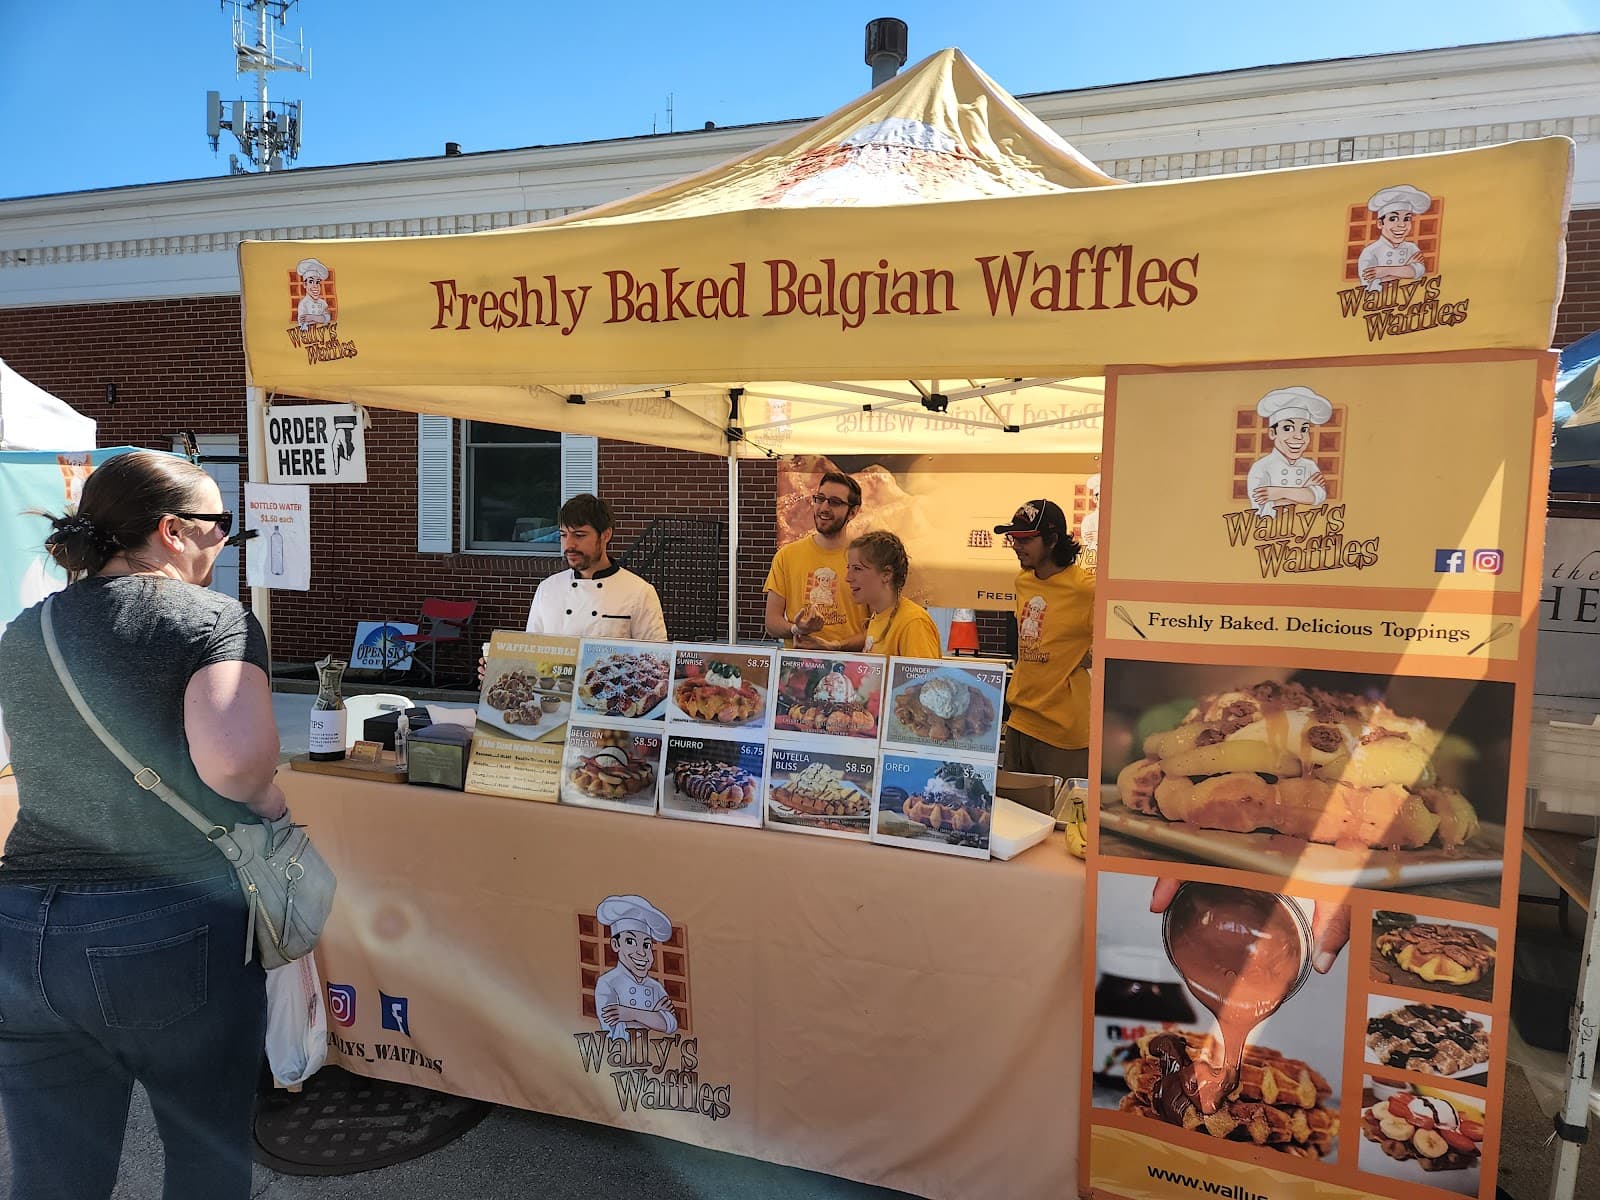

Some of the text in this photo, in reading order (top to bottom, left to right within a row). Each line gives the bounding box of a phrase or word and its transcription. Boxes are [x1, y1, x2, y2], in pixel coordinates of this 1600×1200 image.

[430, 242, 1200, 336] Freshly Baked Belgian Waffles
[1337, 275, 1442, 318] Wally's
[1363, 298, 1469, 341] Waffles
[286, 322, 338, 349] Wally's
[305, 339, 358, 366] Waffles
[269, 415, 329, 446] ORDER
[278, 448, 327, 476] HERE
[250, 501, 303, 511] BOTTLED WATER
[1223, 503, 1346, 548] Wally's
[1255, 535, 1380, 579] Waffles
[1148, 611, 1471, 642] Freshly Baked. Delicious Toppings
[676, 658, 703, 666] SUNRISE
[747, 658, 769, 668] $8.75
[782, 660, 825, 670] CHERRY MAMA
[856, 665, 881, 676] $7.75
[976, 673, 1002, 684] $7.75
[570, 729, 603, 740] BELGIAN
[569, 738, 597, 747] DREAM
[633, 736, 658, 748] $8.50
[669, 739, 704, 750] CHURRO
[740, 744, 764, 756] $6.75
[772, 751, 810, 762] NUTELLA
[775, 761, 798, 771] BLISS
[845, 762, 872, 774] $8.50
[885, 762, 910, 773] OREO
[963, 767, 992, 781] $7.50
[573, 1027, 699, 1074] Wally's
[610, 1067, 731, 1121] Waffles
